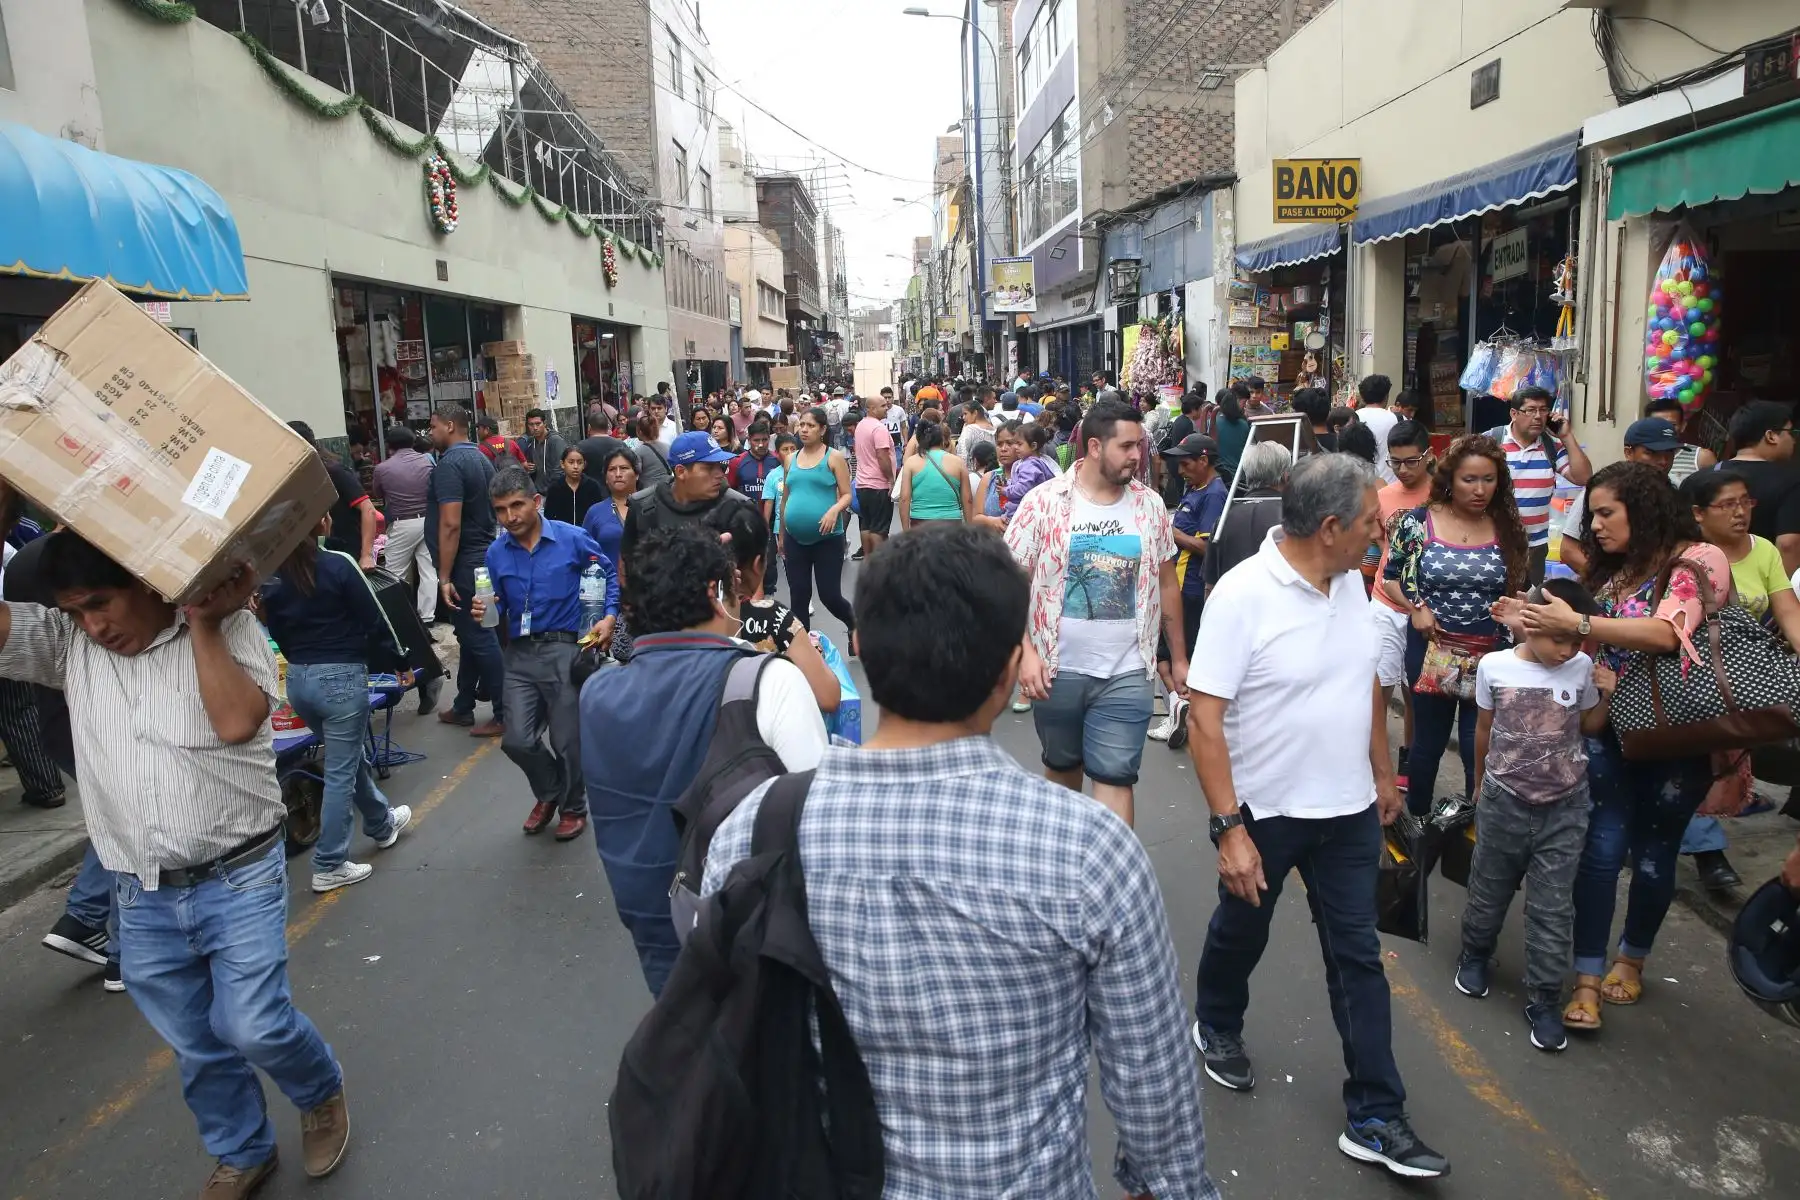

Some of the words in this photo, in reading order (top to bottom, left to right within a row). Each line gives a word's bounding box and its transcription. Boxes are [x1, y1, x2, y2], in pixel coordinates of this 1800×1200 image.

[1276, 160, 1357, 200] BAÑO
[1282, 208, 1303, 216] PASE
[1305, 208, 1316, 216] AL
[1317, 208, 1346, 216] FONDO
[1495, 240, 1526, 270] ENTRADA
[120, 366, 134, 379] CM
[112, 374, 132, 390] KGS
[94, 390, 114, 406] PCS
[102, 382, 124, 399] KGS
[144, 400, 158, 410] 25
[128, 416, 141, 427] 48
[136, 408, 149, 420] 23
[180, 414, 206, 436] MEAS:
[160, 442, 180, 460] QTY:
[1084, 552, 1134, 568] HOLLYWOOD
[746, 617, 768, 634] Oh!
